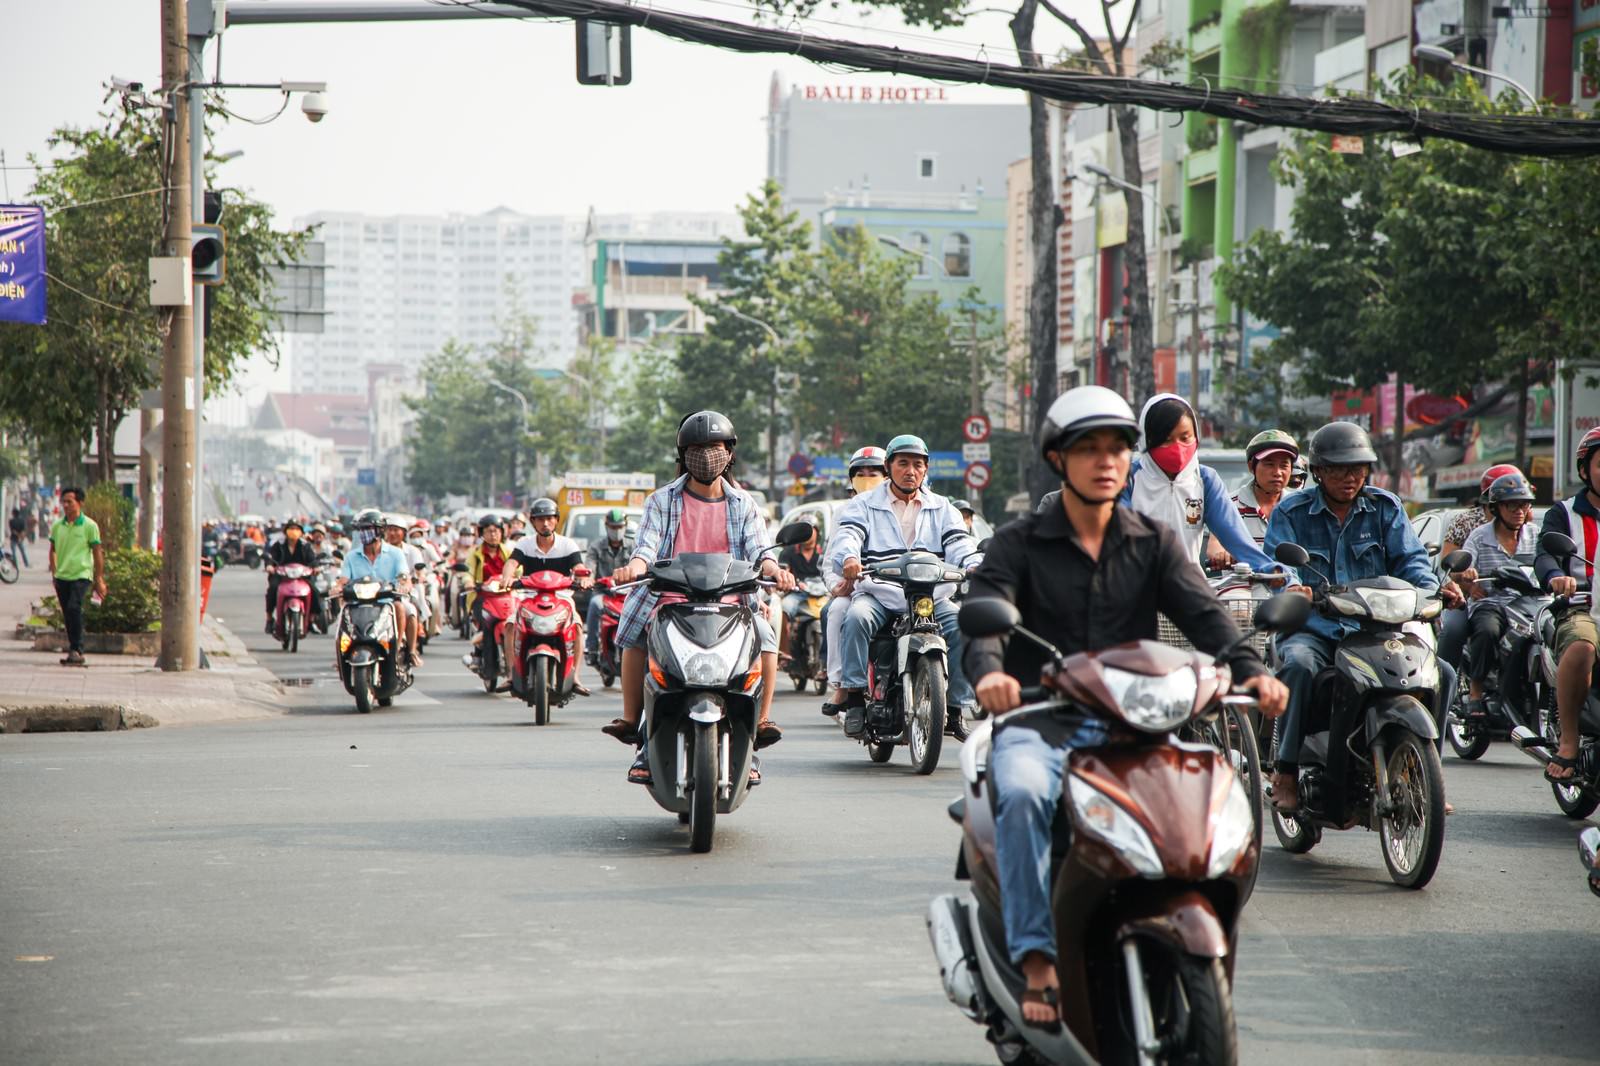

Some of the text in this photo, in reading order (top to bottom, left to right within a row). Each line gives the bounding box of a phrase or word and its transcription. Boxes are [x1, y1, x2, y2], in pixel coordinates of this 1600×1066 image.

[806, 86, 948, 100] BALI B HOTEL
[568, 490, 582, 504] 46
